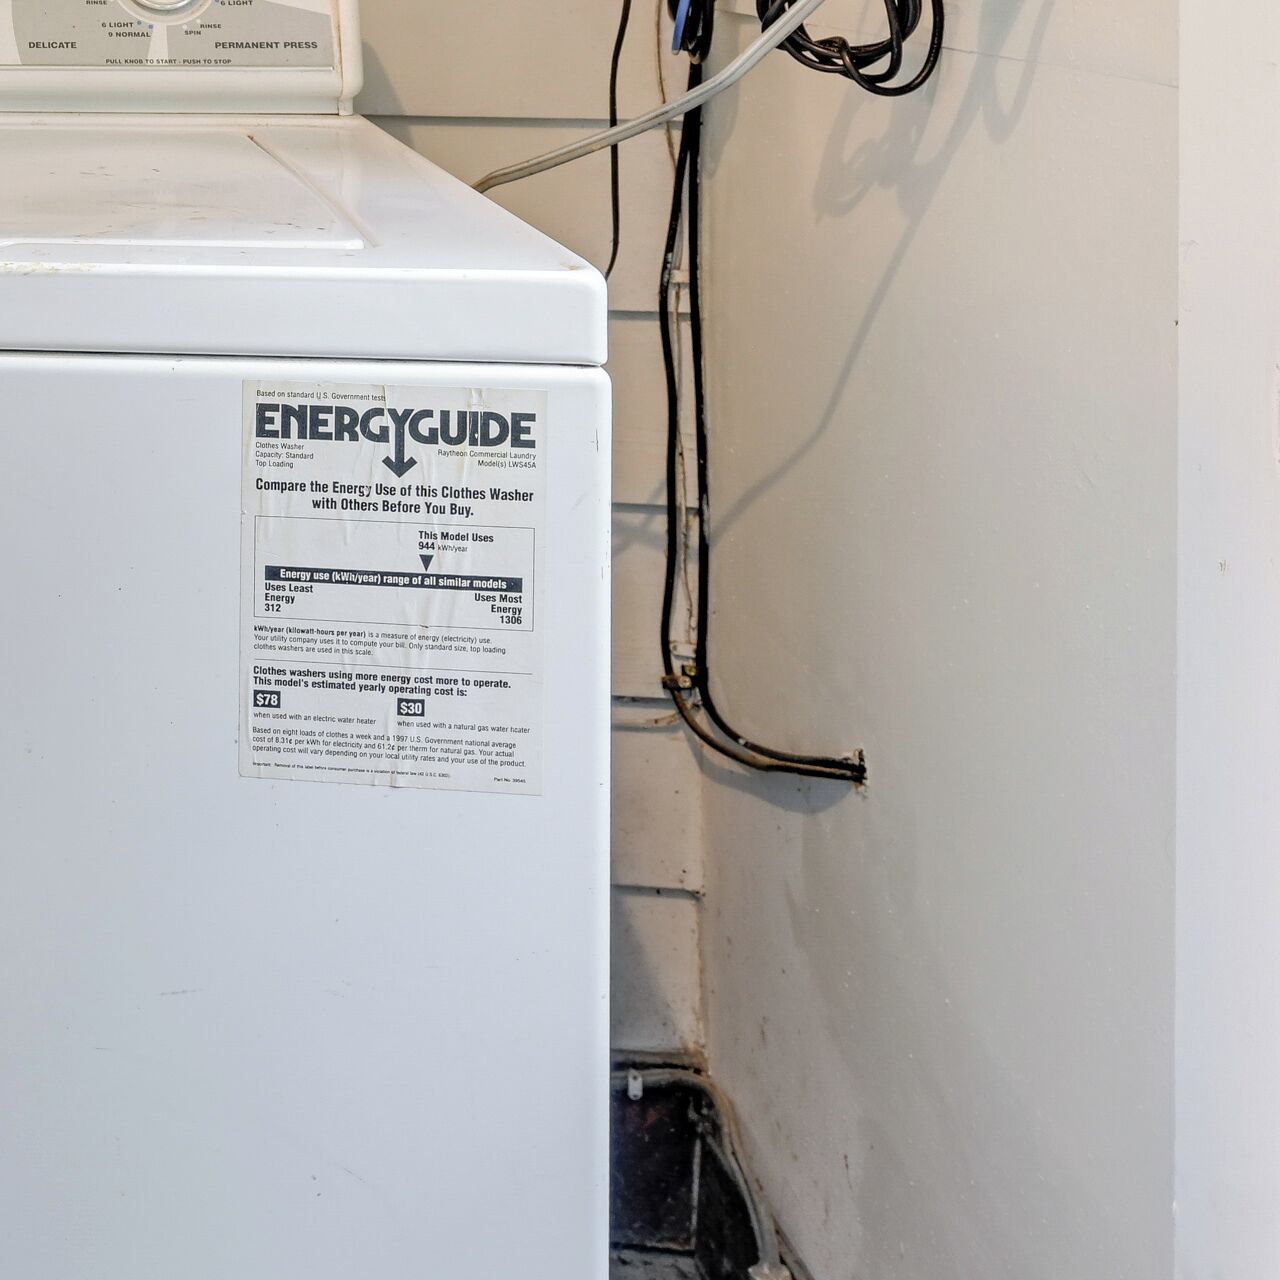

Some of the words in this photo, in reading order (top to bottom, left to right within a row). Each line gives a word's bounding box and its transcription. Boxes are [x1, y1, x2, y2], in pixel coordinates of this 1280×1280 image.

[331, 393, 370, 401] Government
[256, 402, 536, 448] ENERGYGUIDE
[285, 451, 314, 459] Standard
[438, 449, 467, 458] Raytheon
[469, 450, 508, 458] Commercial
[509, 451, 536, 460] Laundry
[256, 460, 266, 468] Top
[268, 460, 294, 469] Loading
[478, 460, 506, 468] Model(s)
[256, 478, 306, 494] Compare
[310, 480, 328, 493] the
[332, 481, 371, 497] Energy
[375, 483, 396, 496] Use
[400, 484, 411, 496] of
[416, 485, 437, 497] this
[441, 486, 485, 499] Clothes
[490, 488, 534, 501] Washer
[312, 497, 336, 510] with
[340, 498, 378, 511] Others
[382, 500, 420, 513] Before
[425, 502, 445, 514] You
[450, 503, 474, 518] Buy.
[418, 531, 437, 540] This
[440, 532, 468, 541] Model
[471, 533, 494, 542] Uses
[418, 542, 436, 550] 944
[437, 544, 468, 552] kWh/year
[280, 569, 310, 581] Energy
[313, 572, 329, 580] use
[332, 571, 381, 585] (kWh/year)
[383, 576, 409, 586] range
[412, 575, 421, 585] of
[424, 575, 436, 585] all
[438, 576, 470, 587] similar
[472, 578, 507, 589] models
[264, 582, 286, 592] Uses
[288, 583, 314, 593] Least
[264, 593, 295, 604] Energy
[474, 593, 496, 602] Uses
[499, 594, 522, 603] Most
[264, 604, 282, 612] 312
[490, 604, 522, 615] Energy
[500, 616, 522, 624] 1306
[252, 666, 286, 676] Clothes
[289, 668, 326, 678] washers
[328, 670, 352, 681] using
[380, 675, 410, 684] energy
[414, 675, 432, 684] cost
[461, 677, 470, 686] to
[473, 678, 511, 690] operate.
[253, 676, 271, 686] This
[274, 678, 308, 688] model's
[311, 680, 356, 690] estimated
[358, 682, 385, 694] yearly
[388, 684, 431, 696] operating
[434, 686, 453, 695] cost
[456, 687, 468, 696] is:
[256, 694, 278, 706] $78
[400, 702, 422, 715] $30
